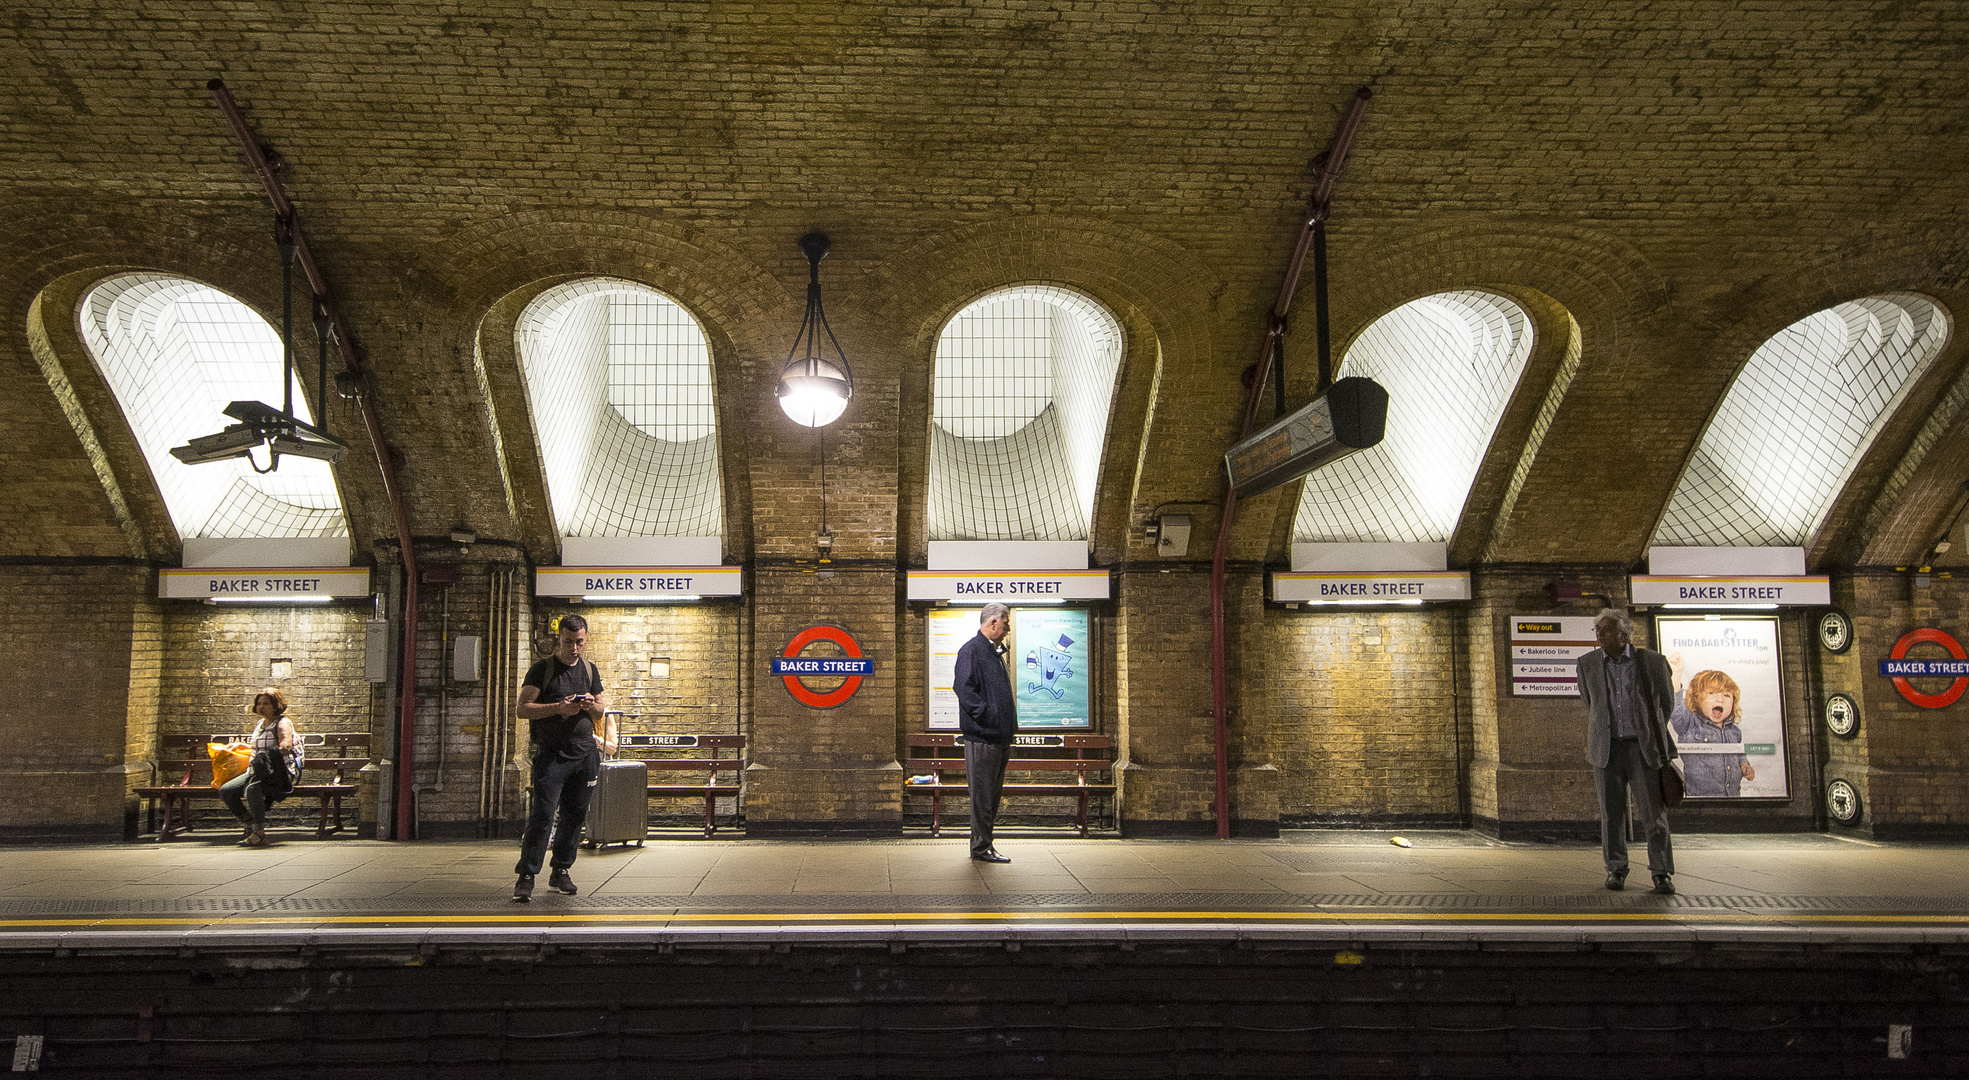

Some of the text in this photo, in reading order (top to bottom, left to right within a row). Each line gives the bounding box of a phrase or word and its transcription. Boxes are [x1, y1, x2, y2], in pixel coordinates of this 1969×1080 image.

[209, 579, 321, 592] BAKER STREET
[585, 578, 693, 590] BAKER STREET
[956, 581, 1062, 593] BAKER STREET
[1319, 583, 1424, 595] BAKER STREET
[1679, 587, 1783, 599] BAKER STREET
[1525, 624, 1540, 632] Way
[780, 661, 866, 672] BAKER STREET
[1887, 663, 1969, 673] BAKER STREET
[1529, 684, 1572, 692] Metropolitan
[228, 736, 252, 744] BAKE
[648, 736, 680, 745] STREET
[1015, 737, 1045, 745] STREET
